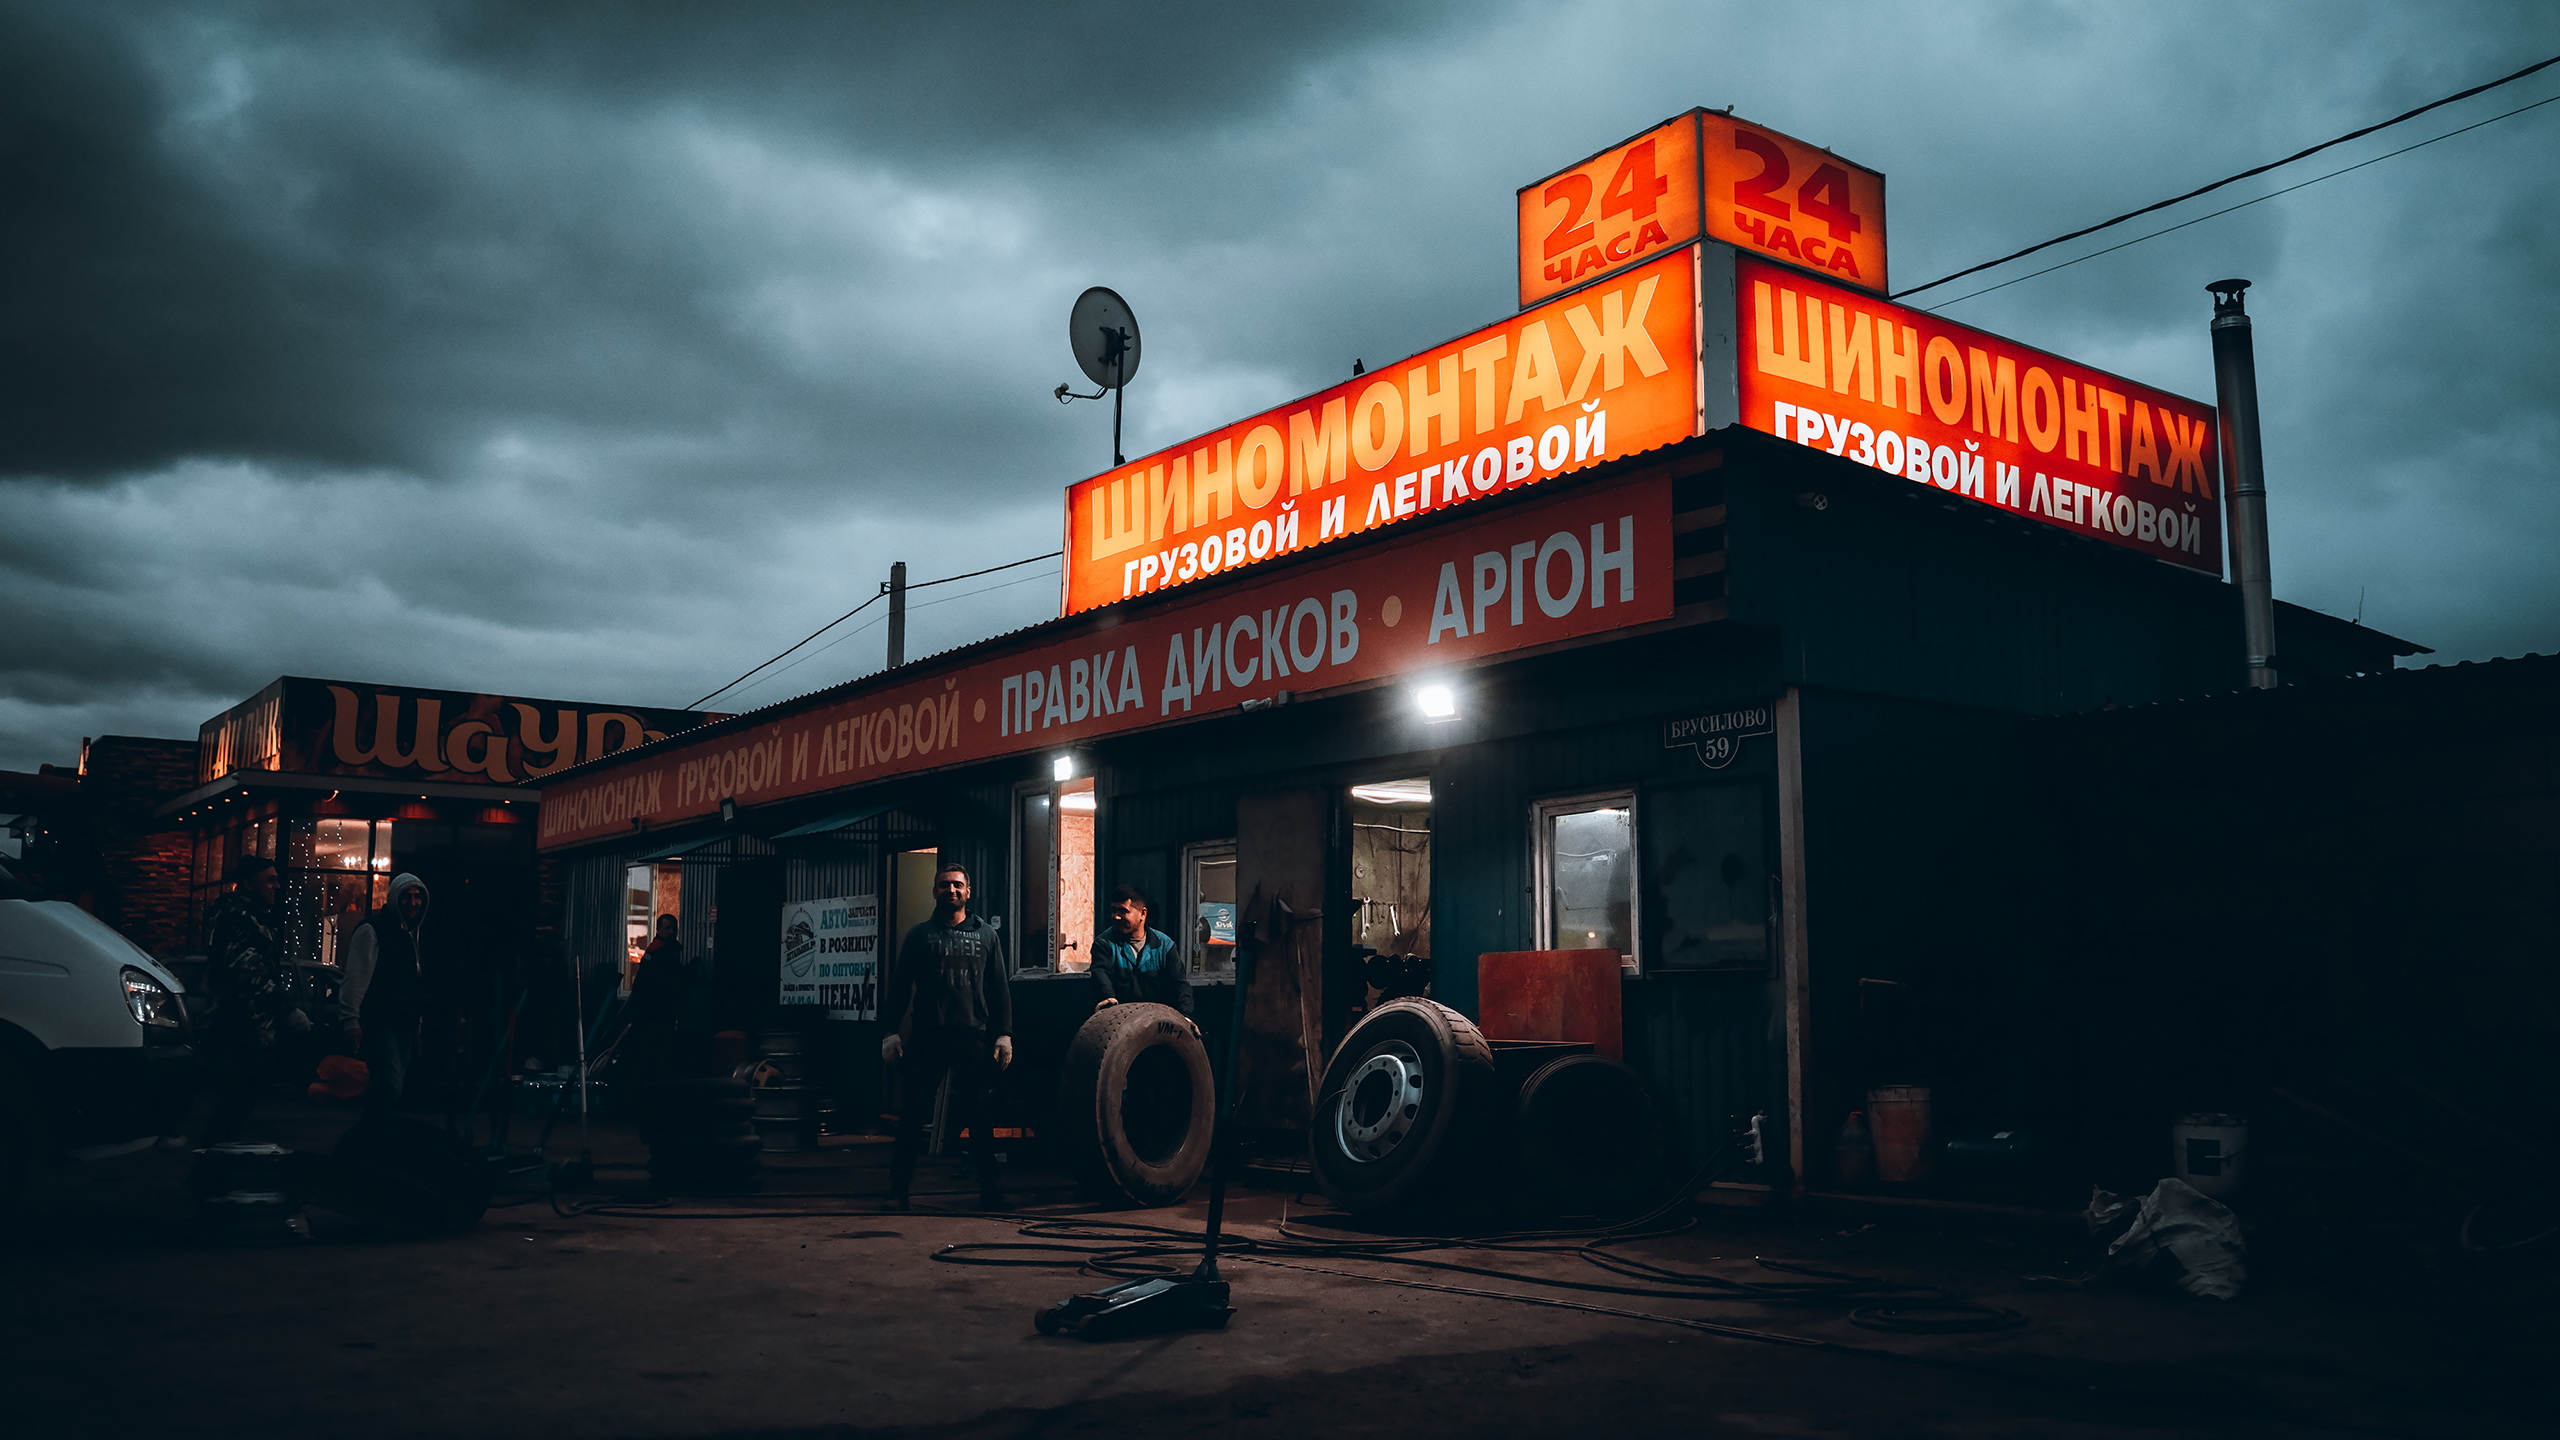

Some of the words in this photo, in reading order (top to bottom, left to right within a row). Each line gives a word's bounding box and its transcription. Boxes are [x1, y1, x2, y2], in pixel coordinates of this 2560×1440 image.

[1544, 138, 1668, 260] 24
[1734, 129, 1861, 244] 24
[1544, 219, 1669, 284] ЧАСА
[1734, 212, 1861, 279] ЧАСА
[1092, 275, 1669, 561] ШИНОМОНТАЖ
[1755, 281, 2212, 499] ШИНОМОНТАЖ
[1123, 502, 1298, 597] ГРУЗОВОЙ
[1321, 495, 1345, 539] И
[1365, 399, 1606, 528] ЛЕГКОВОЙ
[1774, 401, 1985, 499] ГРУЗОВОЙ
[1997, 465, 2020, 509] И
[2030, 472, 2201, 555] ЛЕГКОВОЙ
[543, 769, 662, 837] ШИНОМОНТАЖ
[677, 725, 782, 808] ГРУЗОВОЙ
[791, 733, 808, 782] И
[818, 678, 959, 777] ЛЕГКОВОЙ
[1001, 646, 1143, 737] ПРАВКА
[1161, 589, 1359, 717] ДИСКОВ
[1428, 515, 1635, 645] АРГОН
[1671, 708, 1766, 738] БРУСИЛОВО
[1705, 736, 1729, 760] 59
[819, 964, 831, 977] ПО
[820, 938, 827, 953] В
[828, 935, 877, 954] РОЗНИЦУ
[819, 983, 875, 1010] ЦЕНАМ
